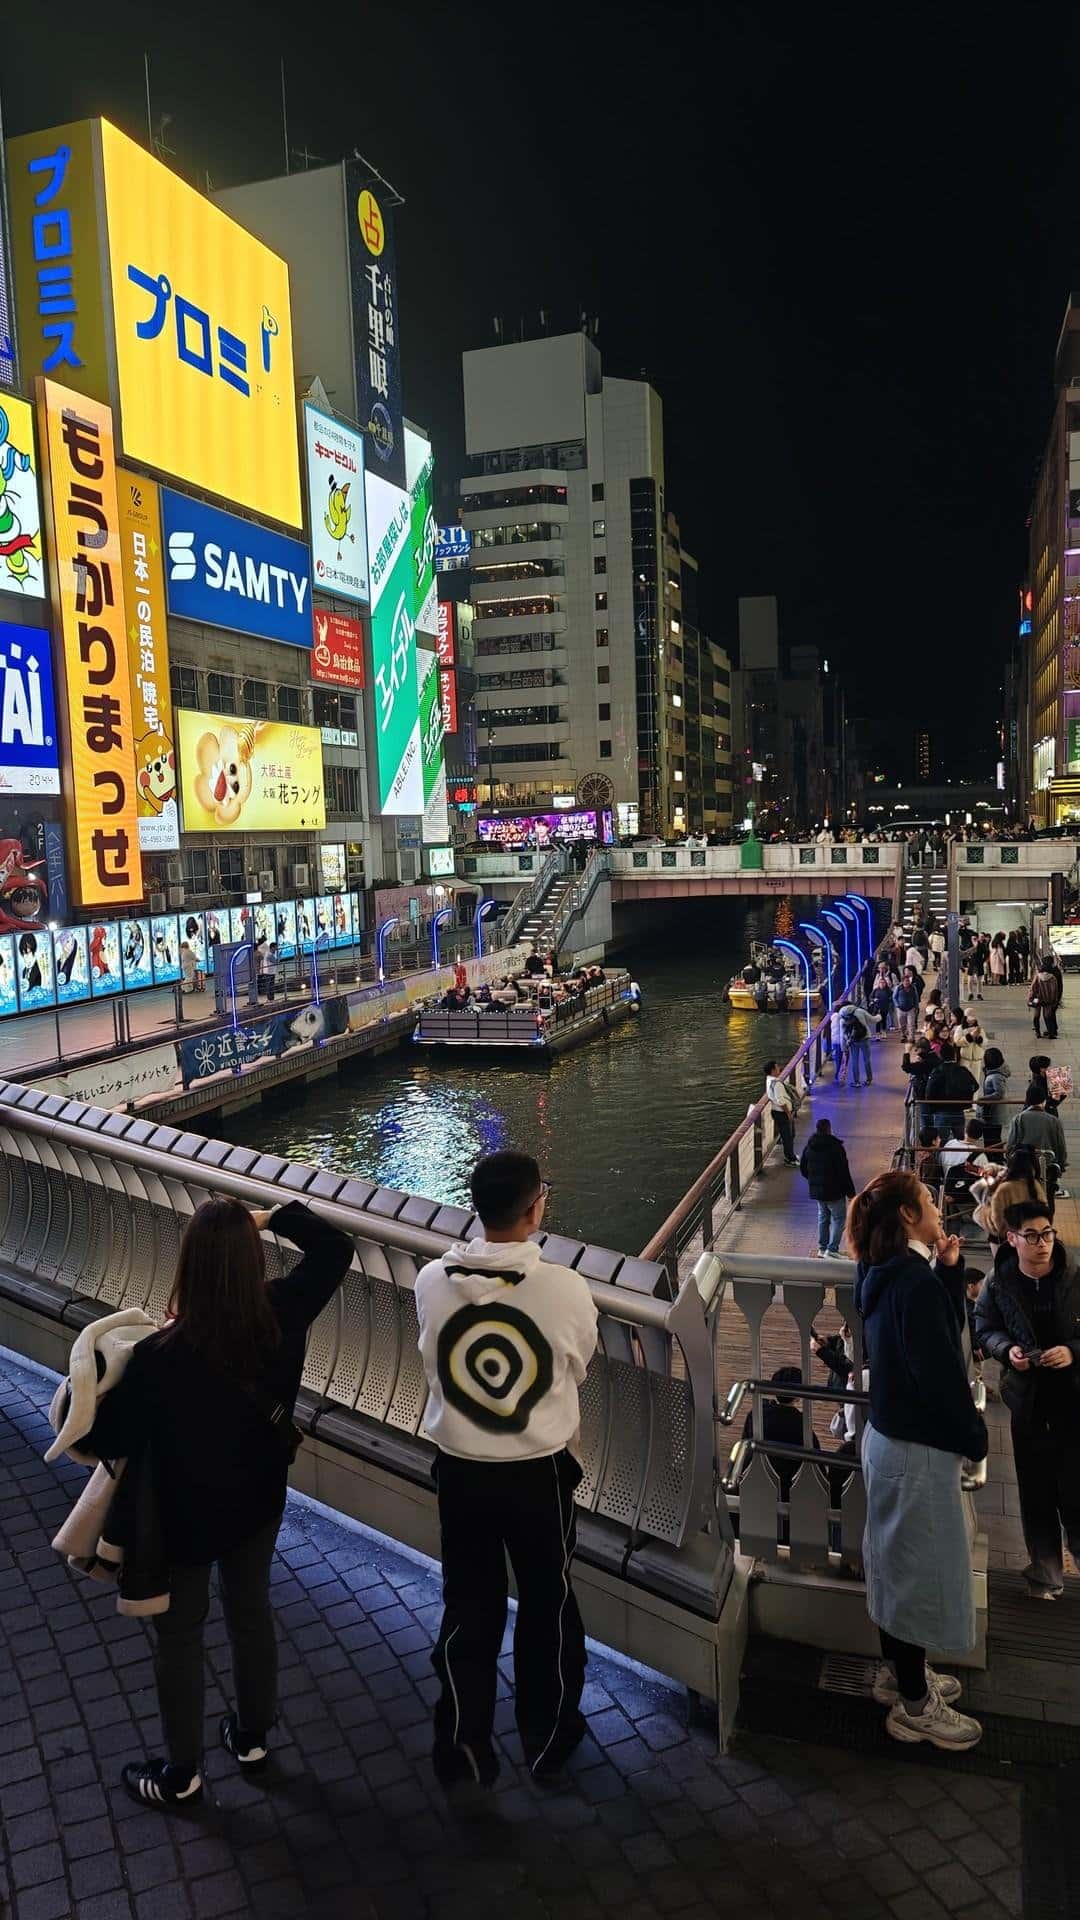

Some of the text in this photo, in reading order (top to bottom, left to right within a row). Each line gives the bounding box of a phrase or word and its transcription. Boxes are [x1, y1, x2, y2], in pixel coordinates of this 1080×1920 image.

[28, 144, 82, 372] プロミス
[364, 195, 381, 248] 占
[365, 263, 388, 400] 千里眼
[314, 440, 357, 473] キュービクル
[204, 543, 308, 613] SAMTY
[370, 501, 409, 585] お部屋探しは
[61, 408, 130, 887] もうかりまっせ
[375, 590, 415, 733] エイブル
[438, 605, 449, 656] カラオケ
[440, 672, 451, 731] ネットカフェ
